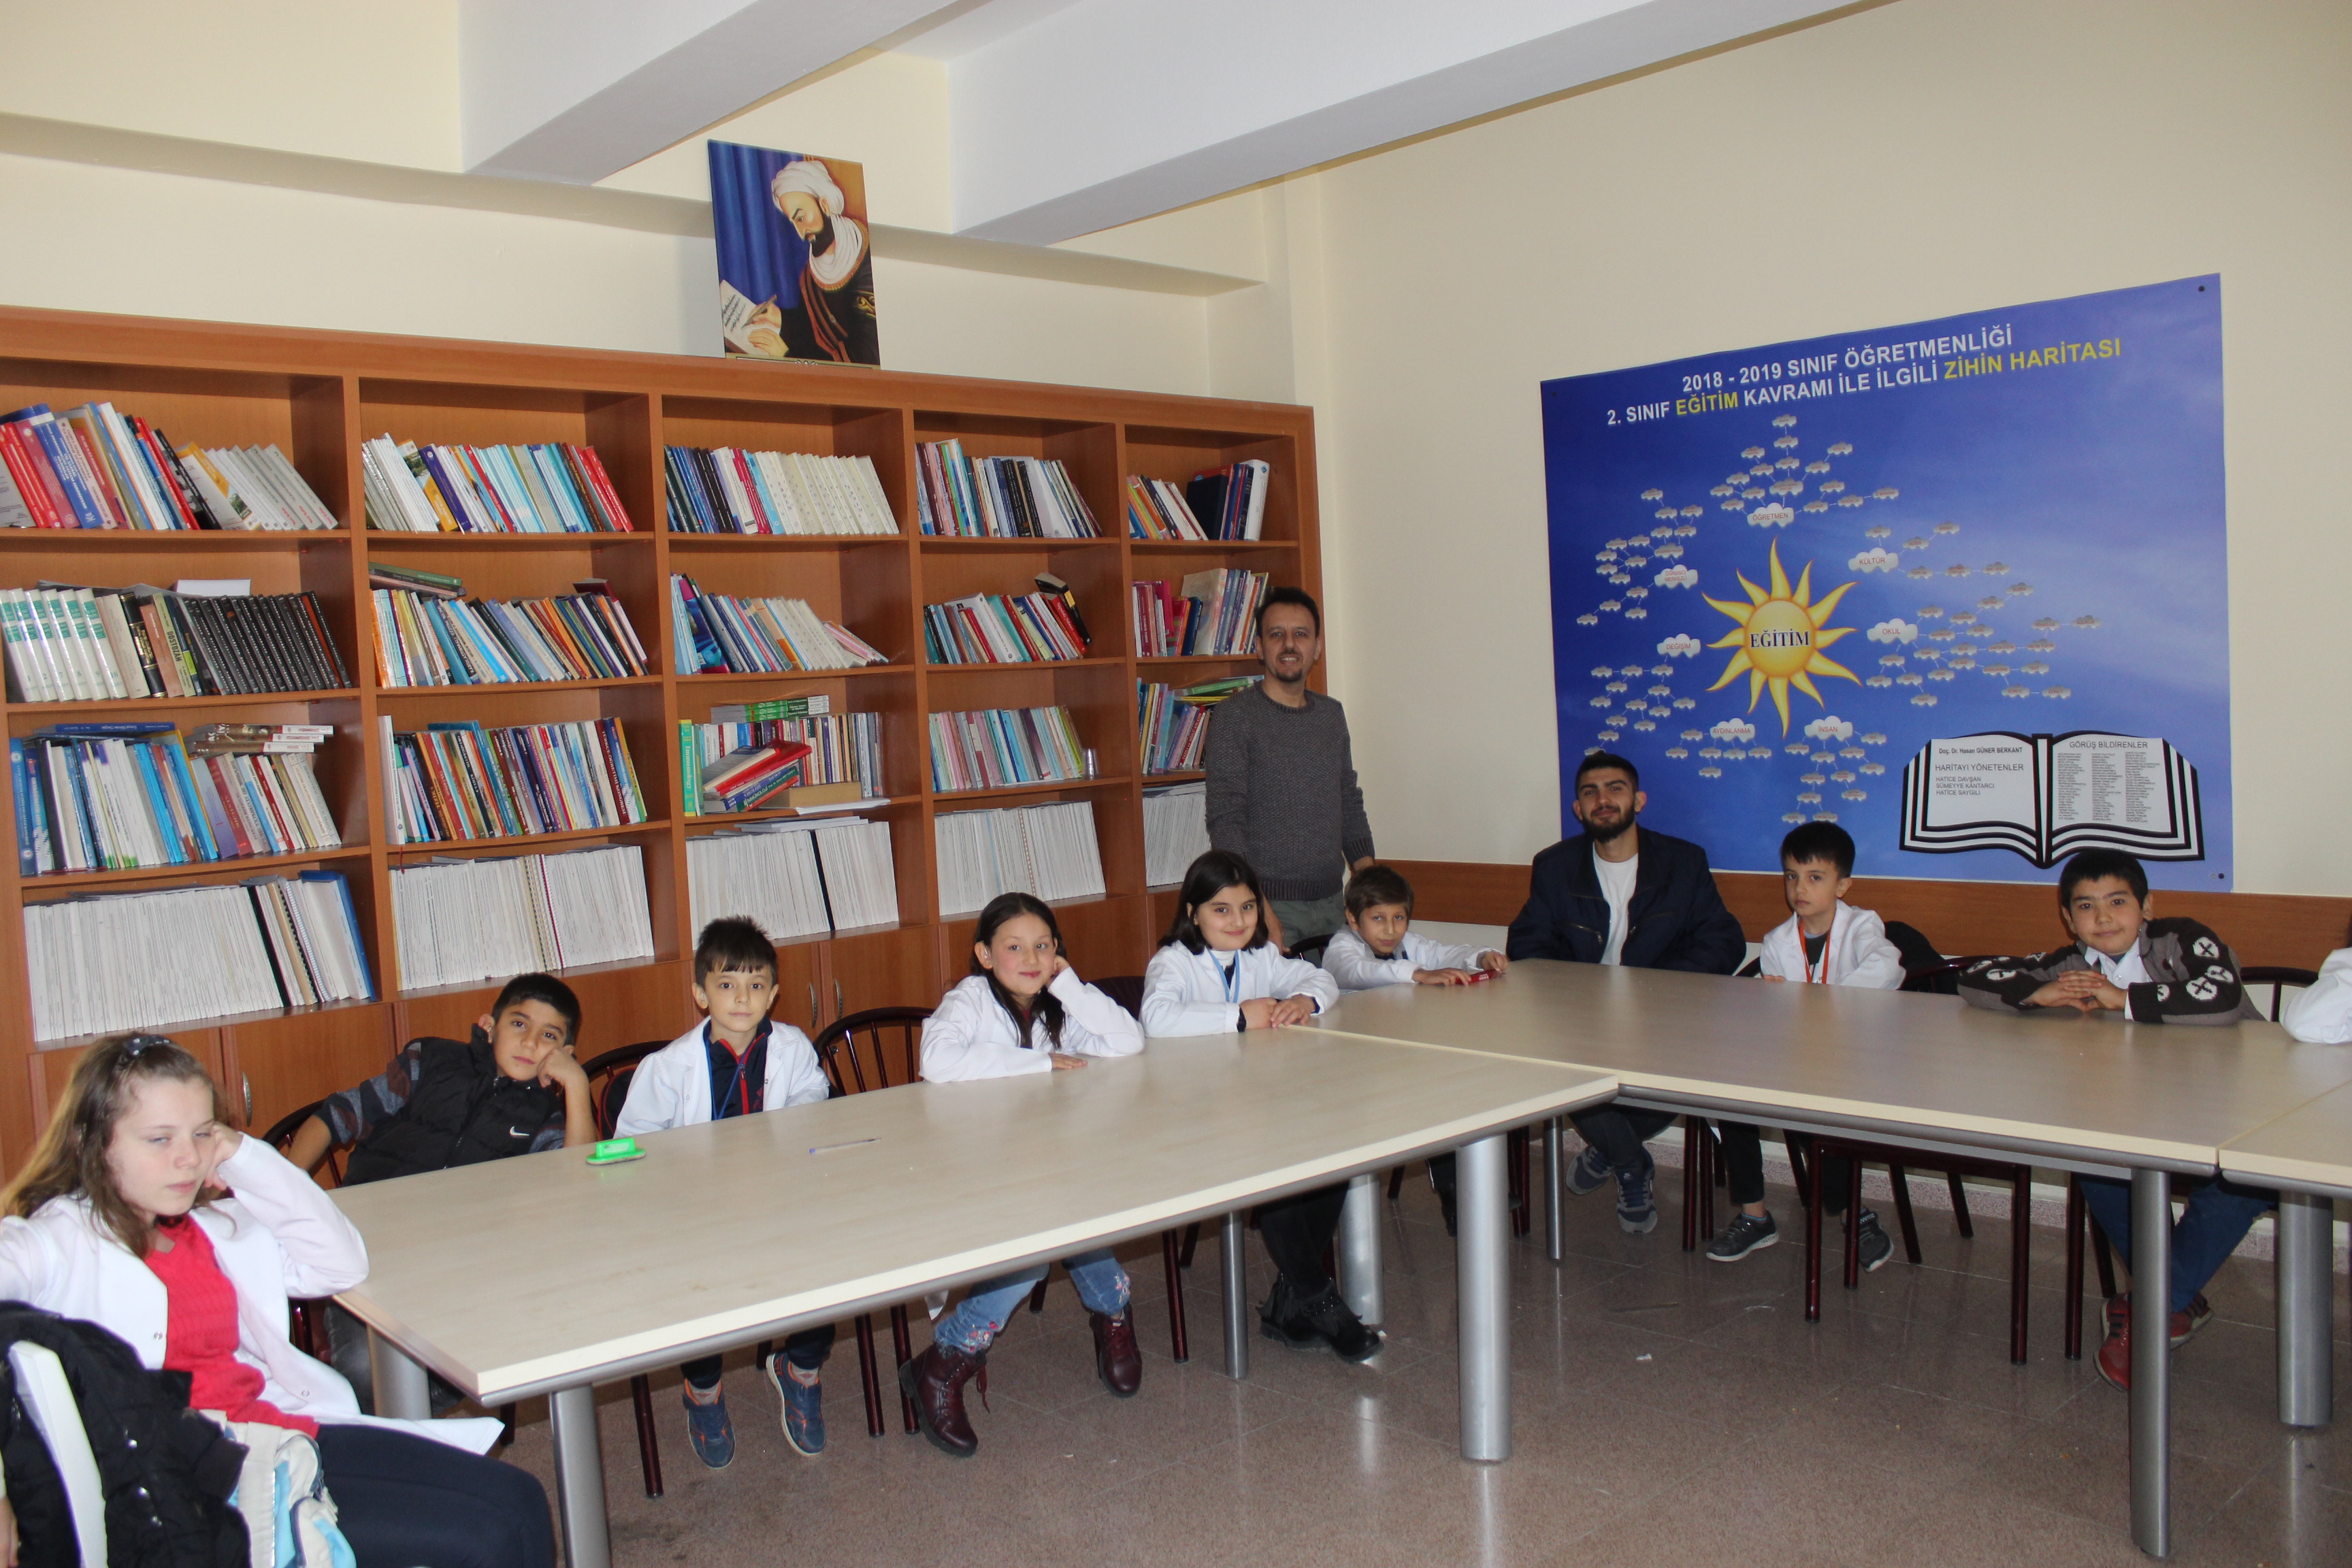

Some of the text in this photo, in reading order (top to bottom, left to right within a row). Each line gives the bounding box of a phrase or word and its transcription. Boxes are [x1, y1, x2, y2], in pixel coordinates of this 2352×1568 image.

[1683, 372, 1722, 392] 2018
[1740, 363, 1782, 385] 2019
[1788, 354, 1838, 377] SINIF
[1845, 323, 2012, 368] ÖĞRETMENLİĞİ
[1607, 338, 2121, 425] 2. SINIF EĞİTİM KAVRAMI İLE İLGİLİ ZİHİN HARİTASI
[1752, 510, 1788, 521] ÖĞRETMEN
[1859, 557, 1886, 565] KÜLTÜR
[1882, 627, 1901, 636] OKUL
[1750, 629, 1810, 648] EĞİTİM
[1818, 725, 1838, 733] İNSAN
[2069, 741, 2096, 749] GÖRÜŞ
[1935, 763, 2024, 771] HARİTAYI YÖNETENLER
[615, 785, 627, 815] KONGRESİ
